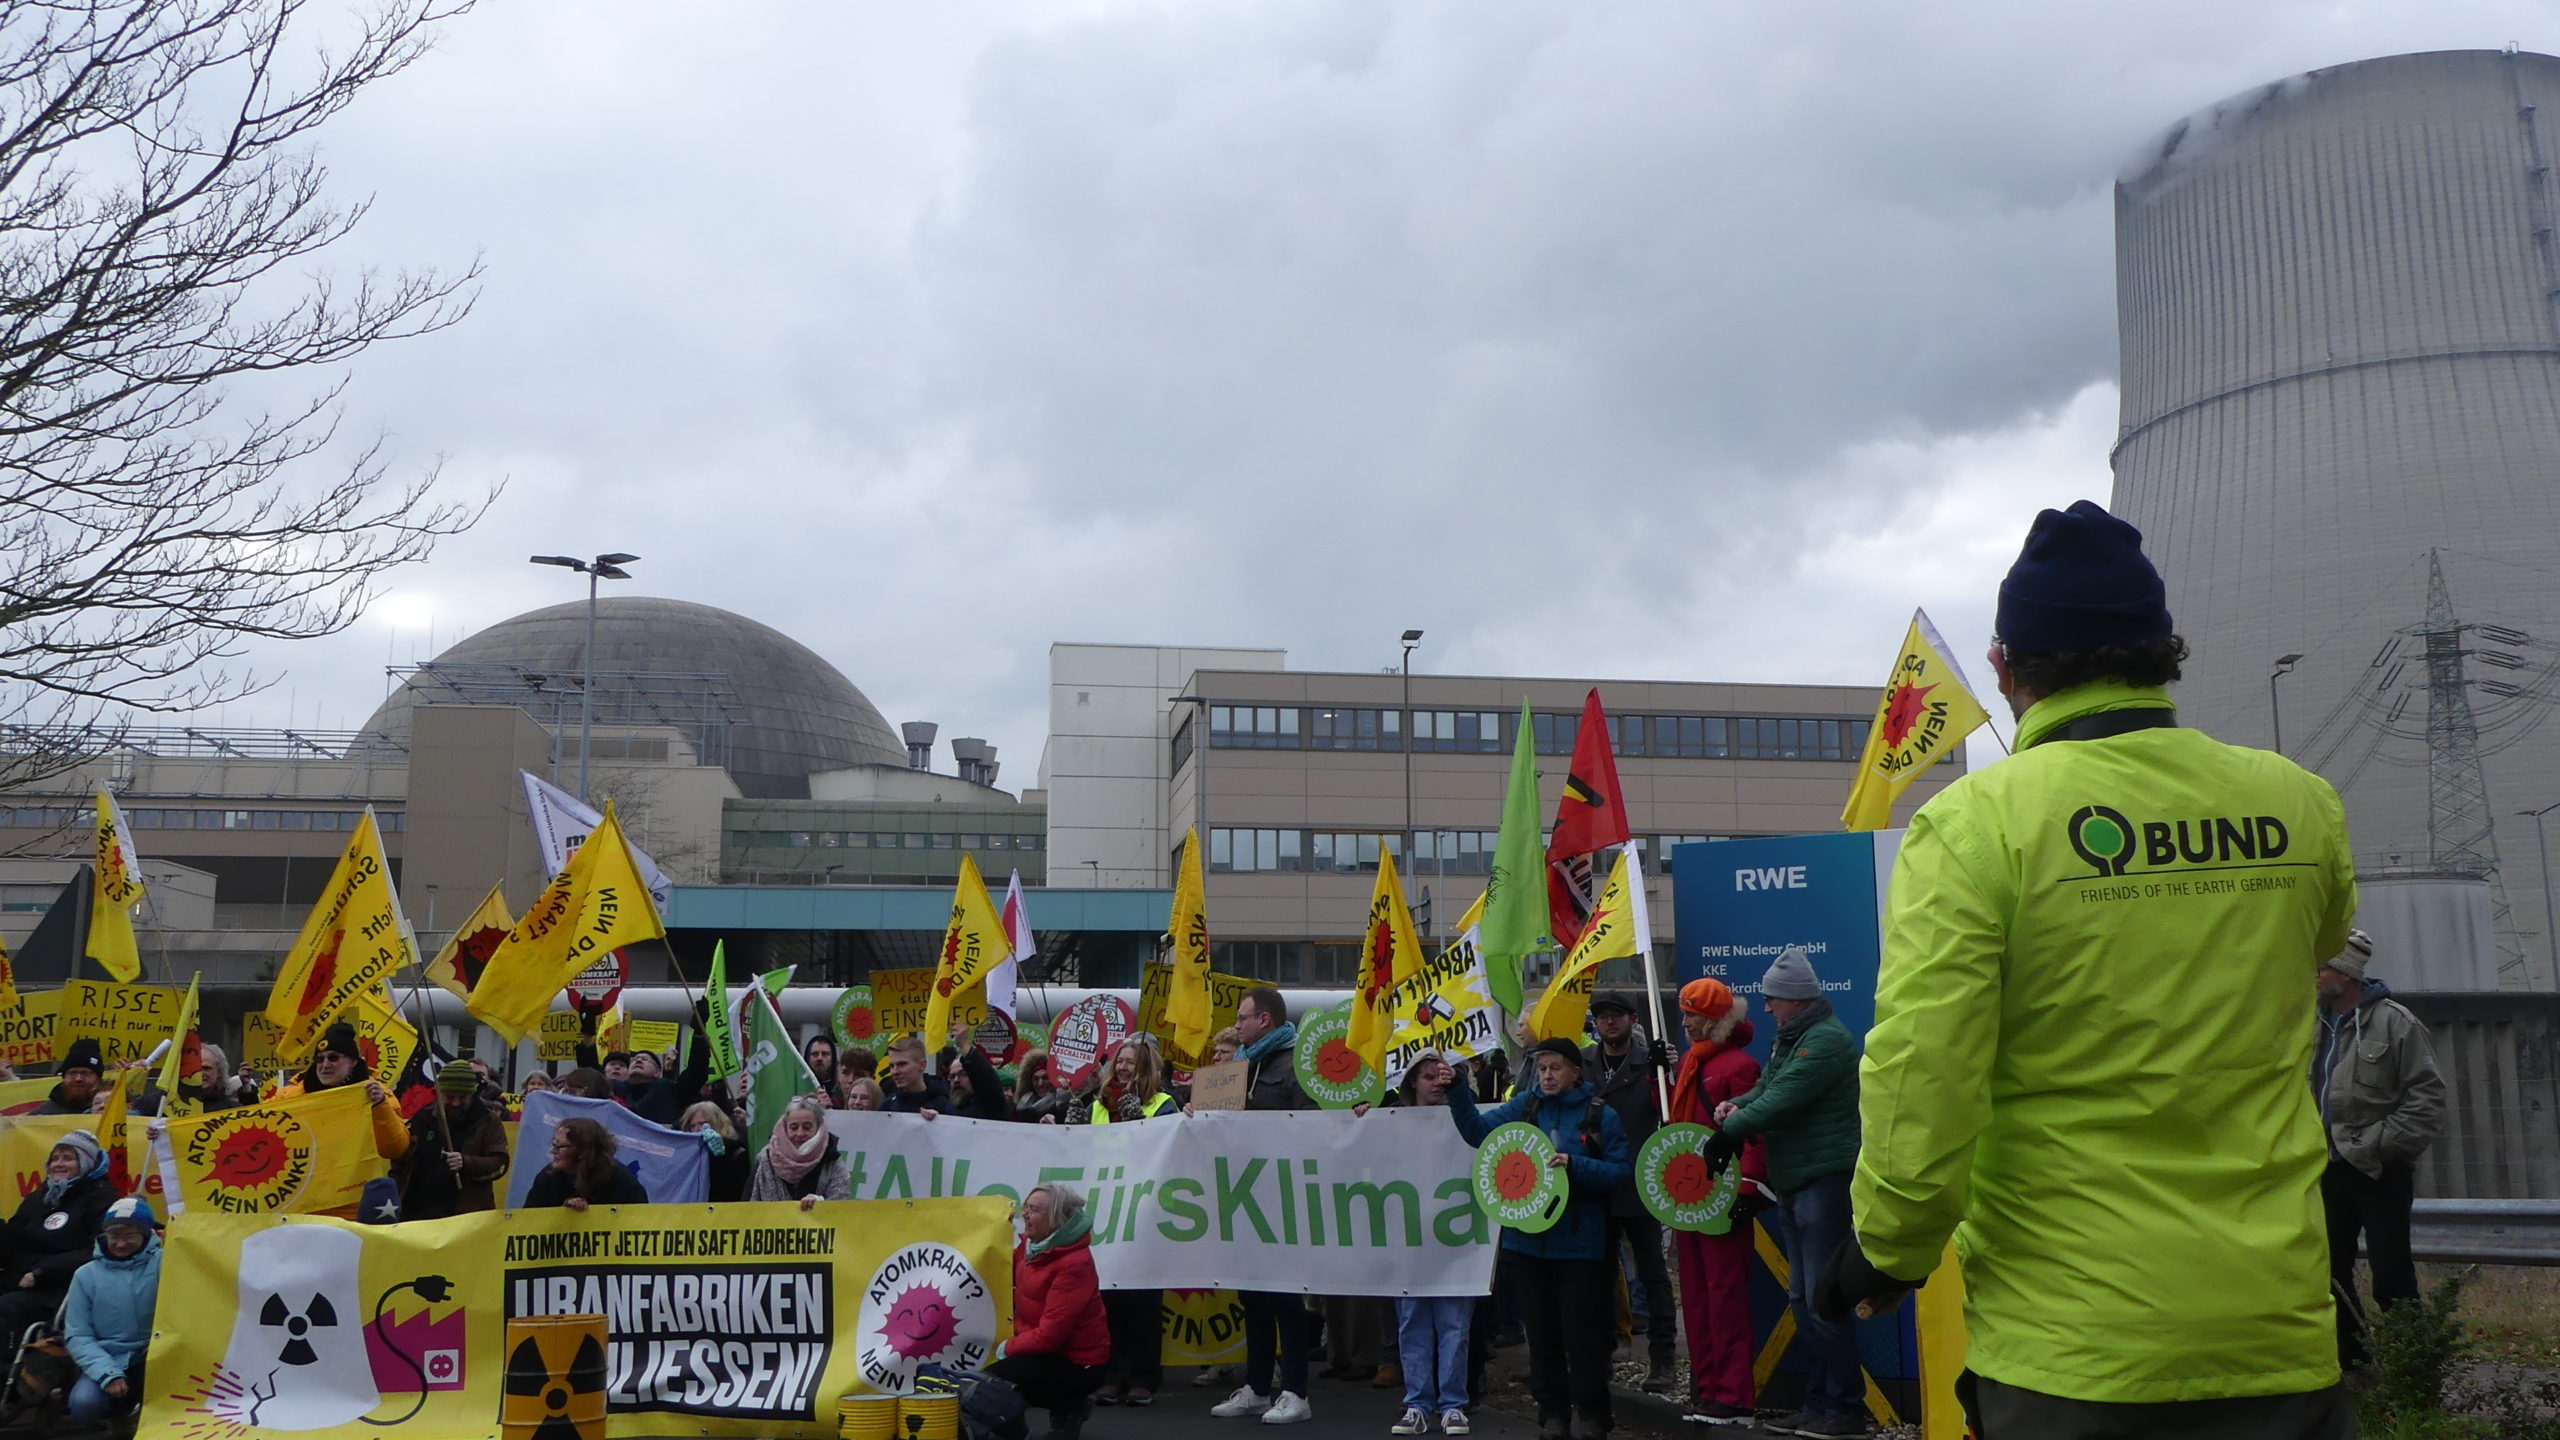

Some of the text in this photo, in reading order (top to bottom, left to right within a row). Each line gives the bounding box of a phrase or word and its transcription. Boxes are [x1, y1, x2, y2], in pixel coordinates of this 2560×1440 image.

[2142, 815, 2289, 866] BUND
[1735, 865, 1808, 892] RWE
[2081, 876, 2297, 904] FRIENDS OF THE EARTH GERMANY
[1702, 945, 1731, 958] RWE
[1733, 943, 1784, 957] Nuclear
[576, 970, 618, 978] TOMKRAFT
[1702, 964, 1728, 976] KKE
[82, 985, 163, 1014] RISSE
[712, 1002, 728, 1029] und
[0, 1013, 57, 1043] PORT
[69, 1013, 117, 1030] nicht
[127, 1020, 152, 1032] nur
[541, 1014, 577, 1033] EUER
[717, 1031, 736, 1072] Wind
[1050, 1046, 1094, 1062] ABSCHALTEN!
[1055, 1038, 1096, 1052] ATOMKRAFT
[1301, 1019, 1349, 1072] ATOMKRA
[1307, 1077, 1361, 1102] SCHLUSS
[187, 1109, 301, 1166] ATOMKRAFT?
[206, 1146, 310, 1214] NEIN DANKE
[1478, 1129, 1526, 1206] ATOMKRAFT?
[1644, 1130, 1695, 1212] ATOMKRAFT?
[1498, 1189, 1549, 1221] SCHLUSS
[1674, 1189, 1731, 1224] SCHLUSS
[504, 1227, 836, 1262] ATOMKRAFT JETZT DEN SAFT ABDREHEN!
[870, 1247, 984, 1306] ATOMKRAFT?
[514, 1272, 824, 1335] URANFABRIKEN
[1161, 1304, 1204, 1346] EIN
[607, 1338, 825, 1411] LIESSEN!
[860, 1347, 905, 1391] NEIN
